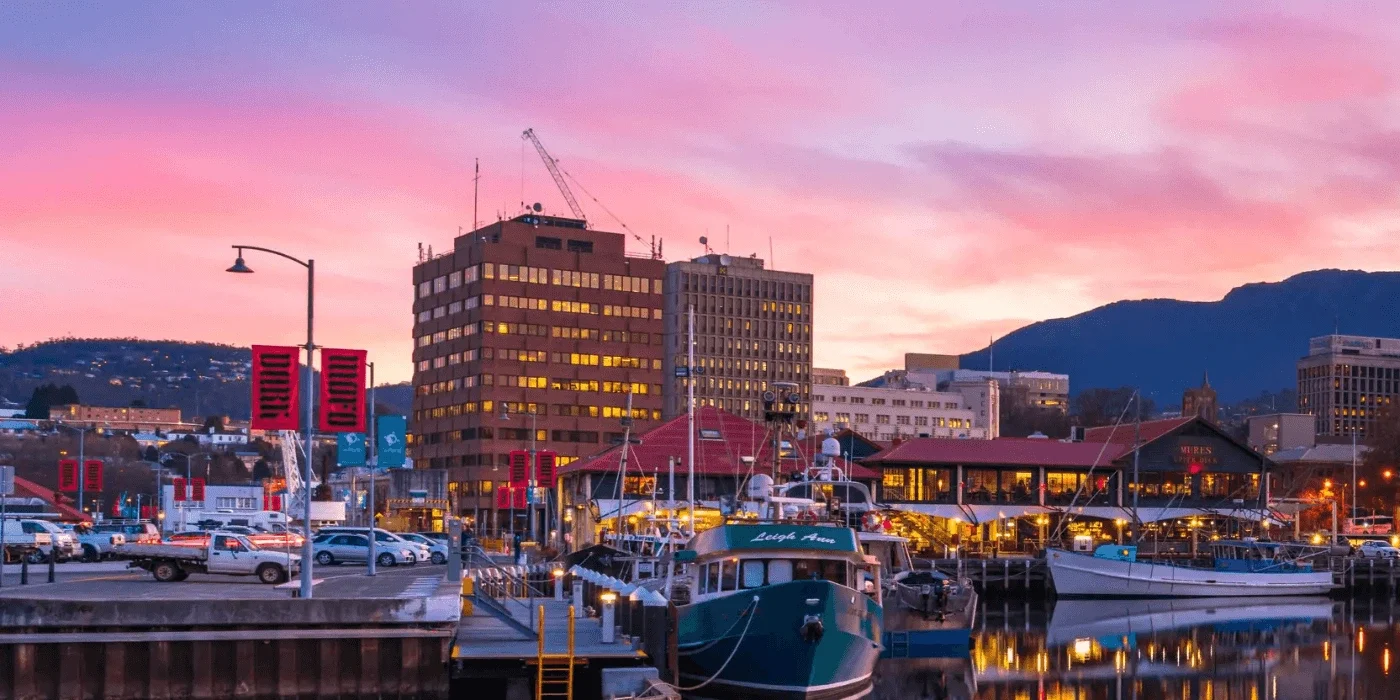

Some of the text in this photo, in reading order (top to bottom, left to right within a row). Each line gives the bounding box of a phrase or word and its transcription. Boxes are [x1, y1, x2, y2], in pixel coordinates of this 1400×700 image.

[259, 353, 291, 419] DARK
[328, 355, 358, 427] MOFO
[750, 531, 836, 544] Leigh Ann
